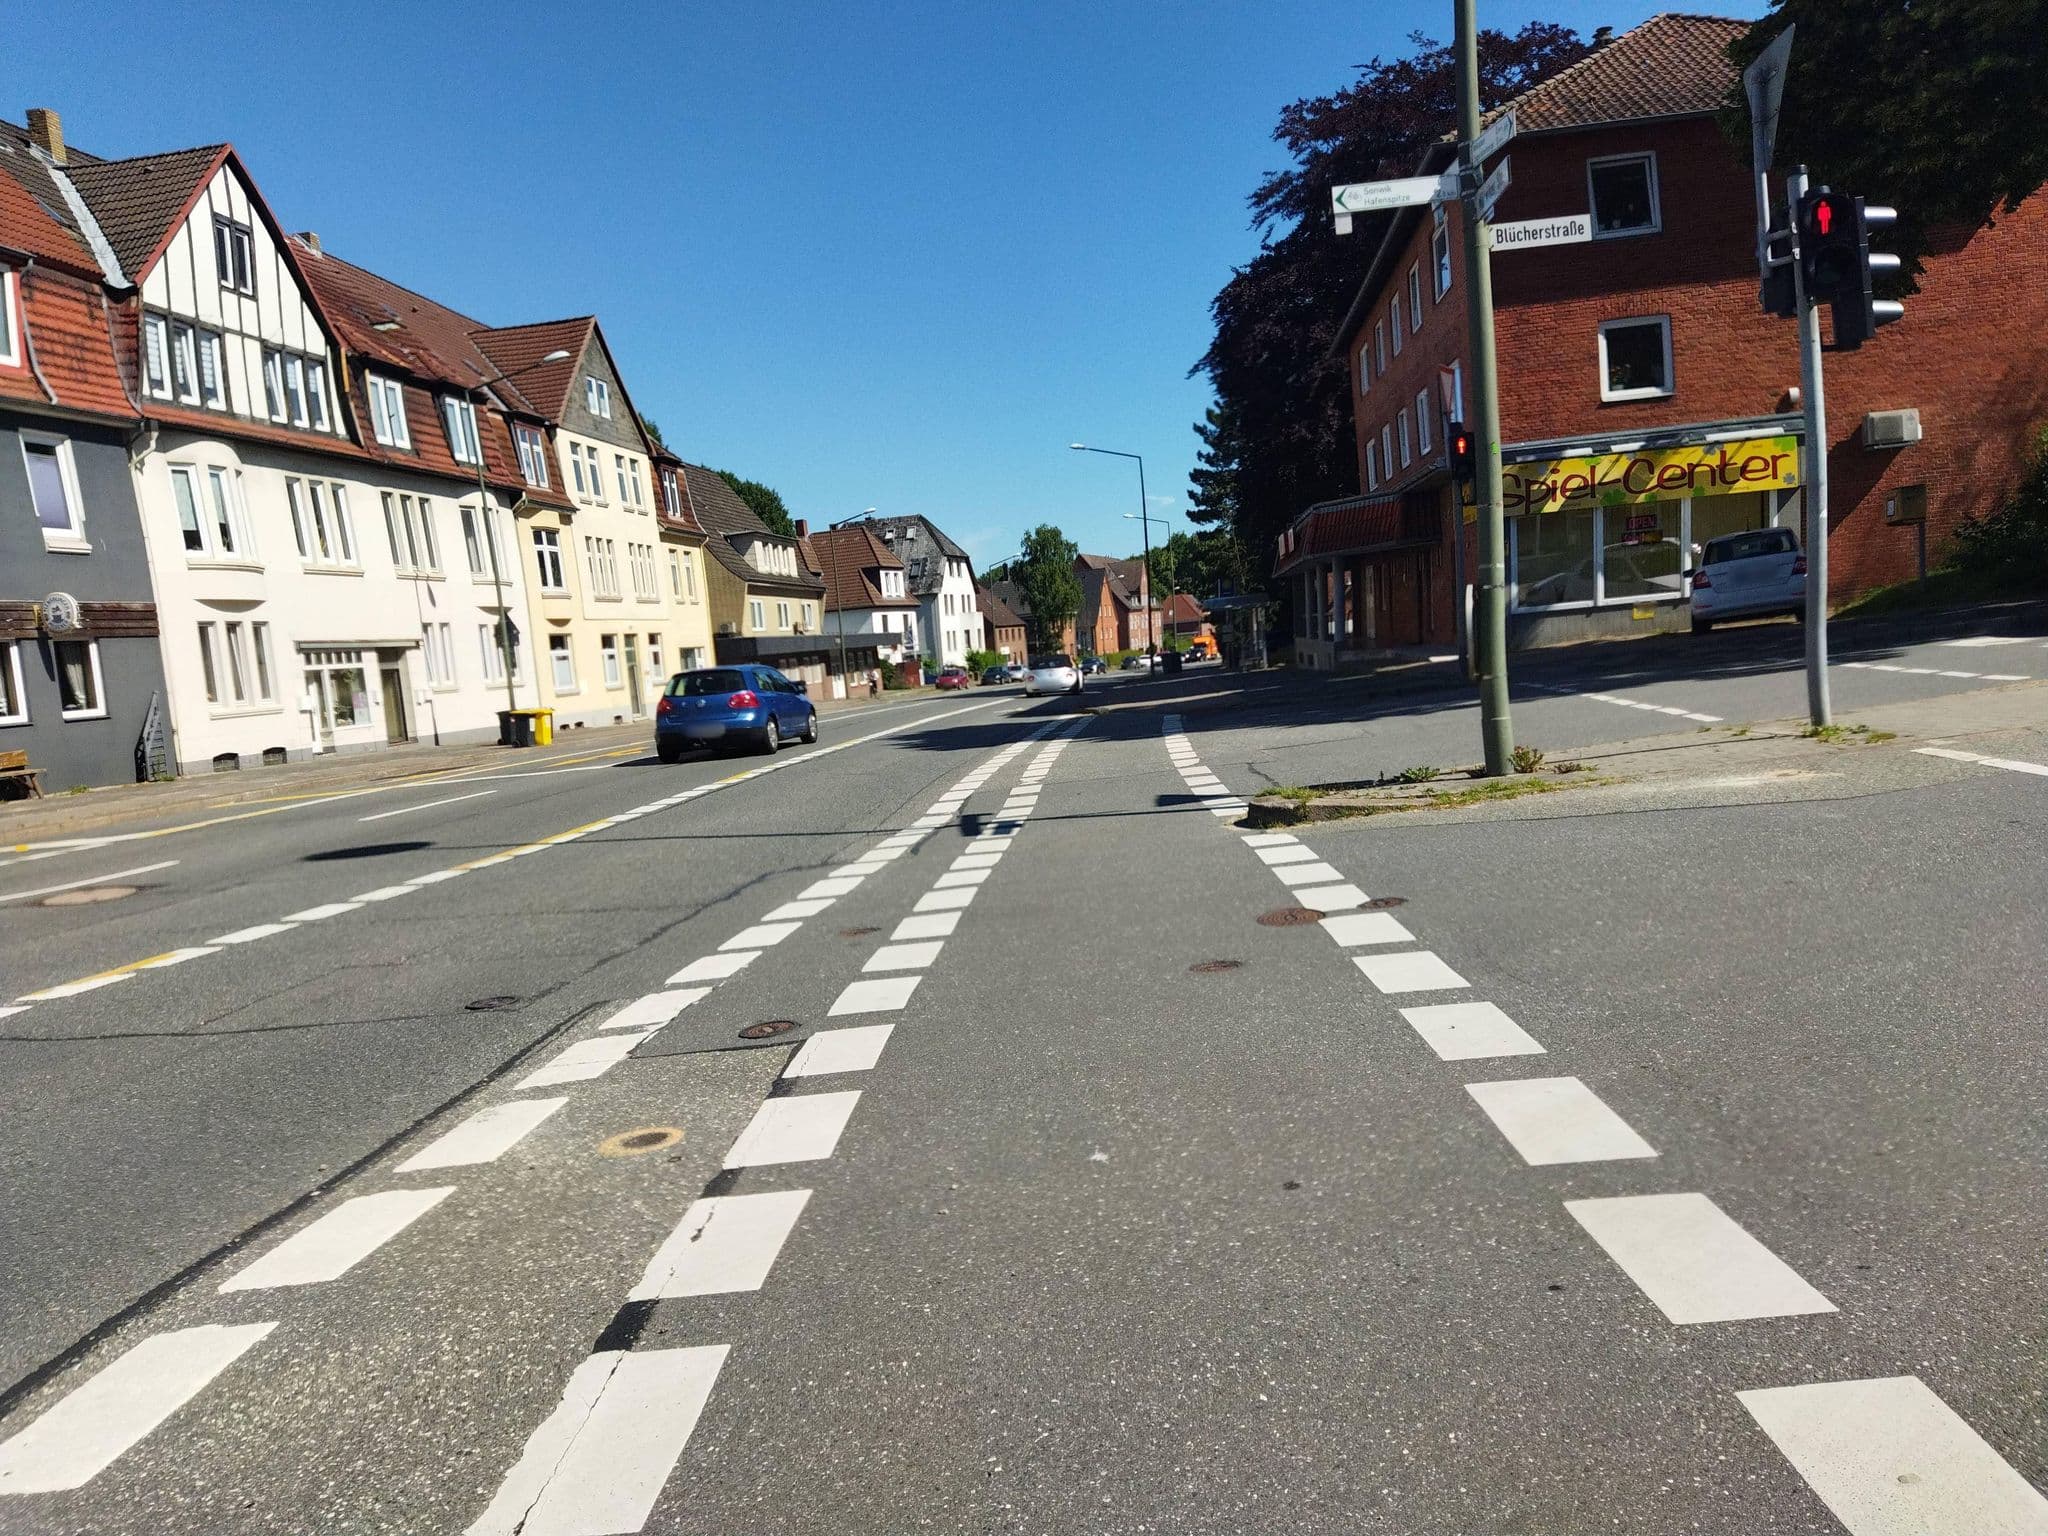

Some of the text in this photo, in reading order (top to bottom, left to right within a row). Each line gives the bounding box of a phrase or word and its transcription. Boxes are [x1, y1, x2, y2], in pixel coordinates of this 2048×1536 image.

[1364, 195, 1410, 206] Hafenspitze
[1495, 220, 1585, 245] Blücherstraße
[1628, 516, 1655, 529] OPEN
